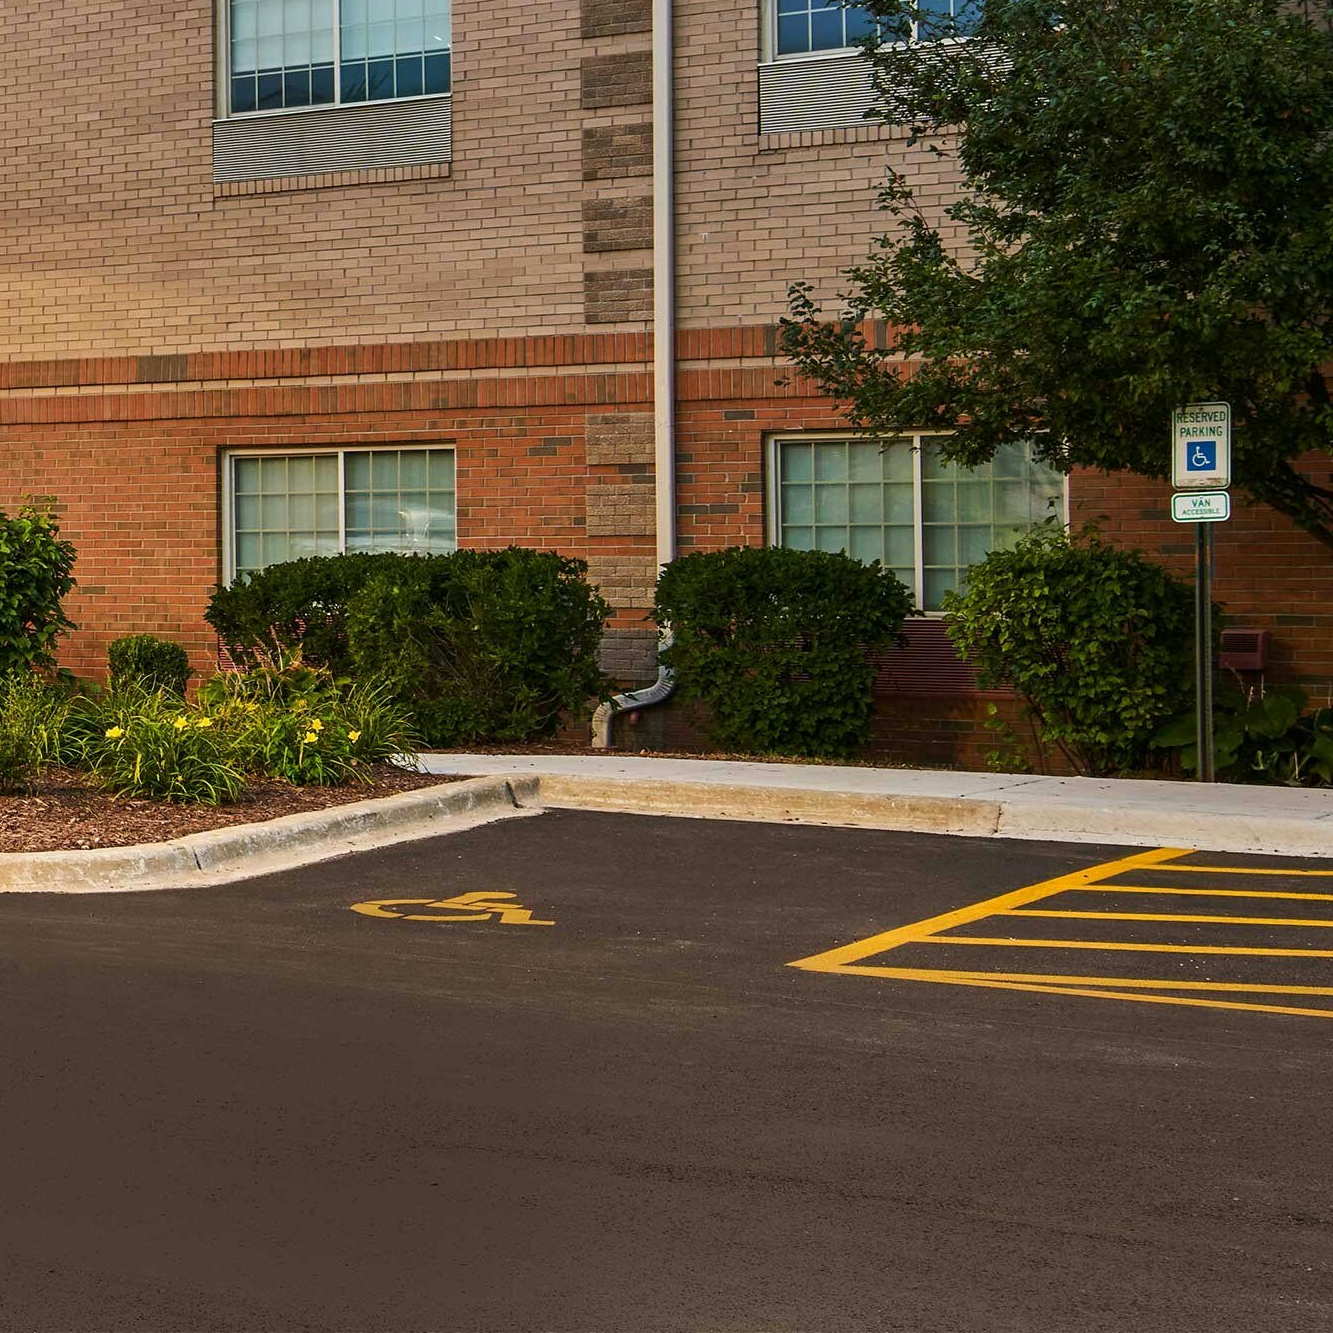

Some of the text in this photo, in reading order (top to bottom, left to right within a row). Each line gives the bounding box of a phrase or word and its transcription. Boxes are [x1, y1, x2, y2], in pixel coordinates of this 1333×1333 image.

[1176, 411, 1226, 423] RESERVED
[1180, 426, 1223, 437] PARKING
[1191, 498, 1211, 507] VAN
